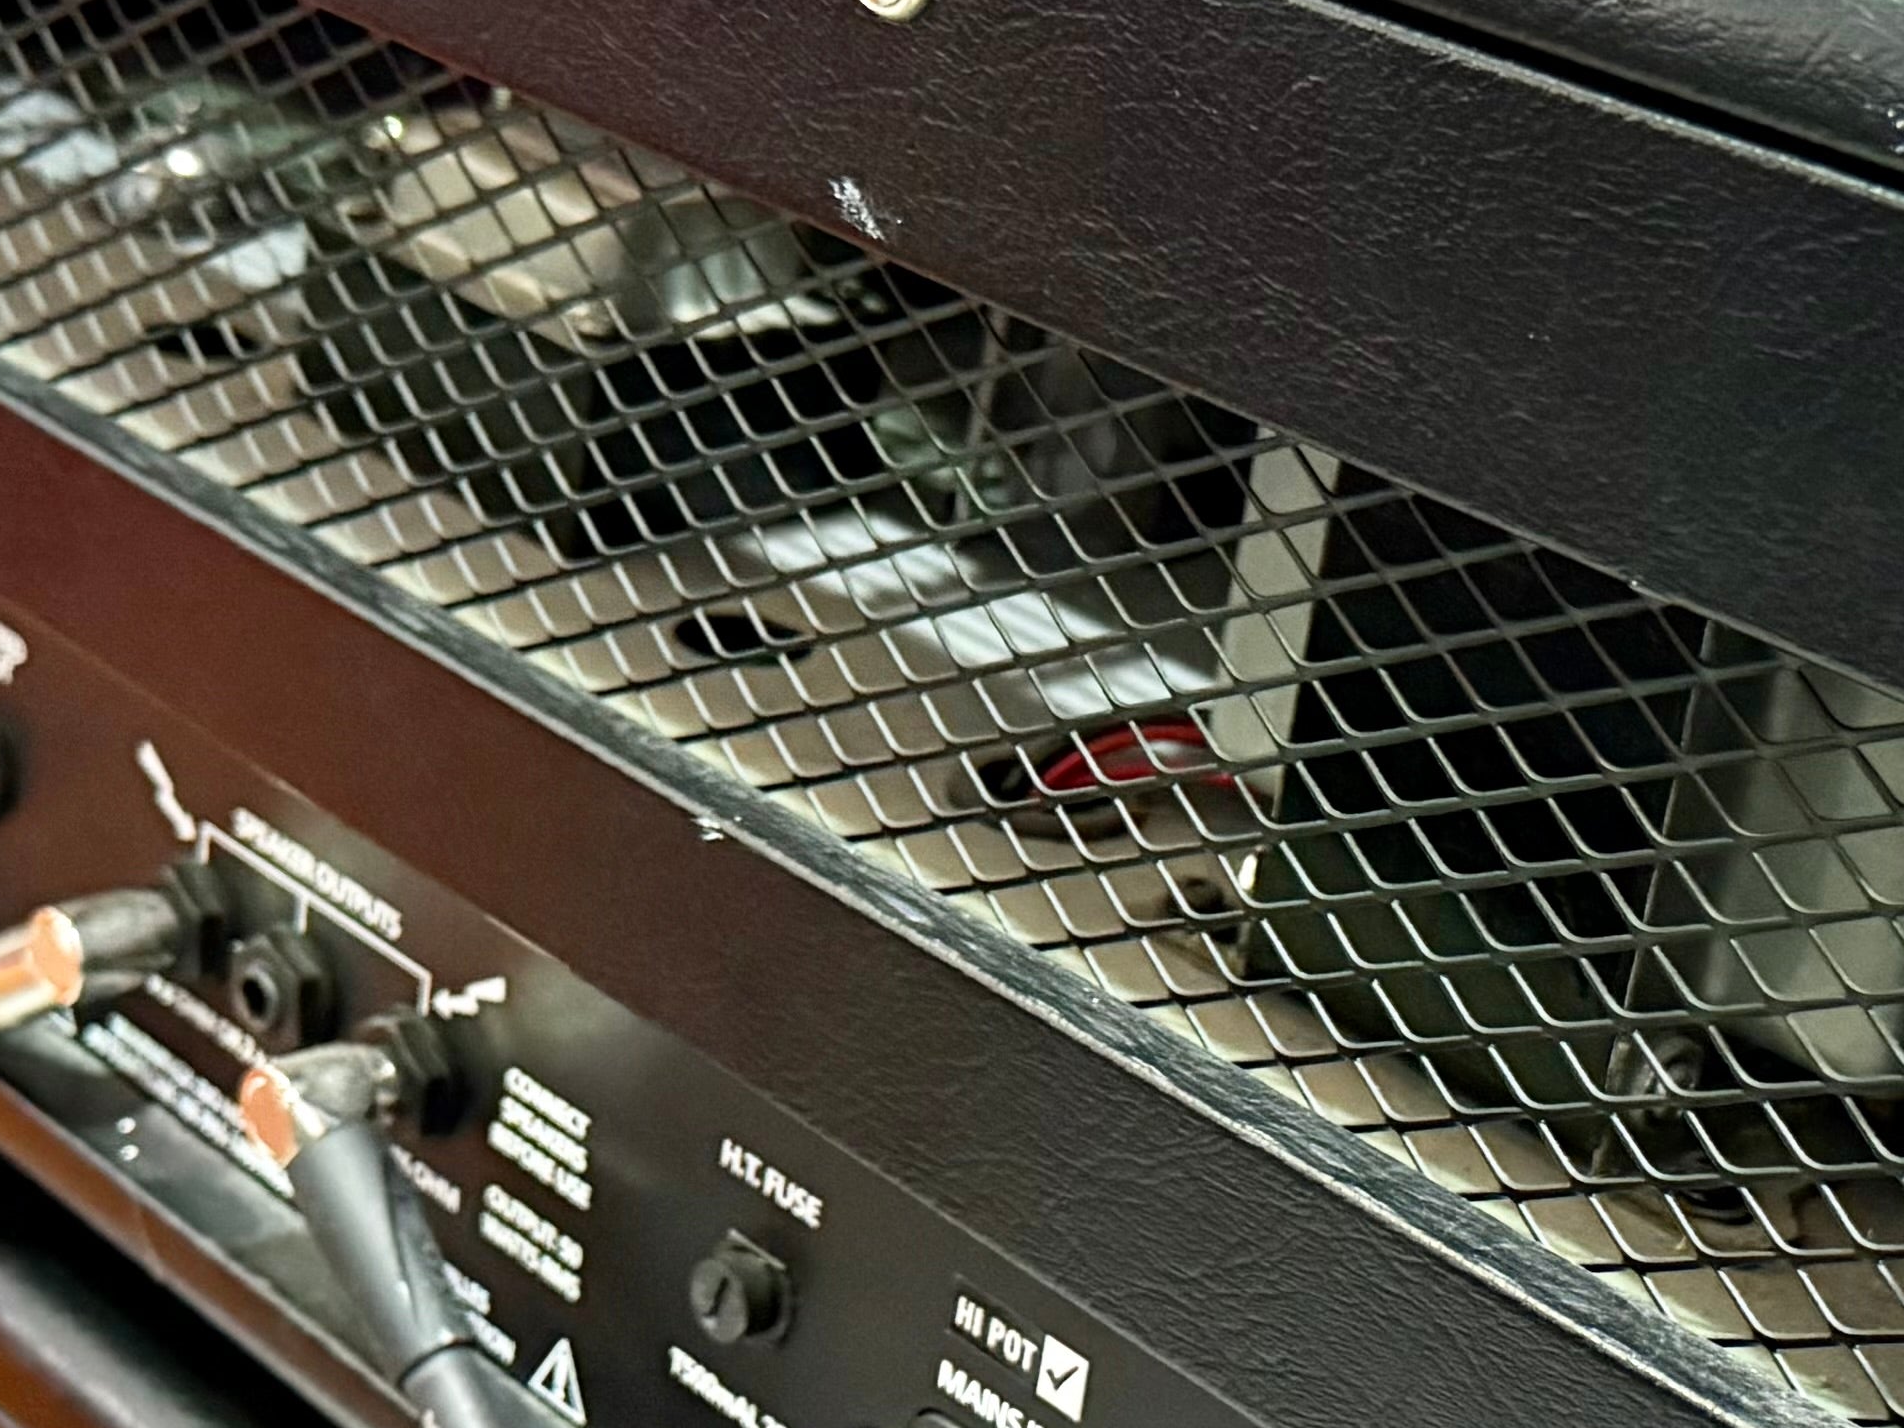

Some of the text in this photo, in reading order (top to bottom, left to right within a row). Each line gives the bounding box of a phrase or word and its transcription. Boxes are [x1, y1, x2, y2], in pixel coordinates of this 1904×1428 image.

[762, 1166, 824, 1229] FUSE
[954, 1295, 1039, 1373] HI POT
